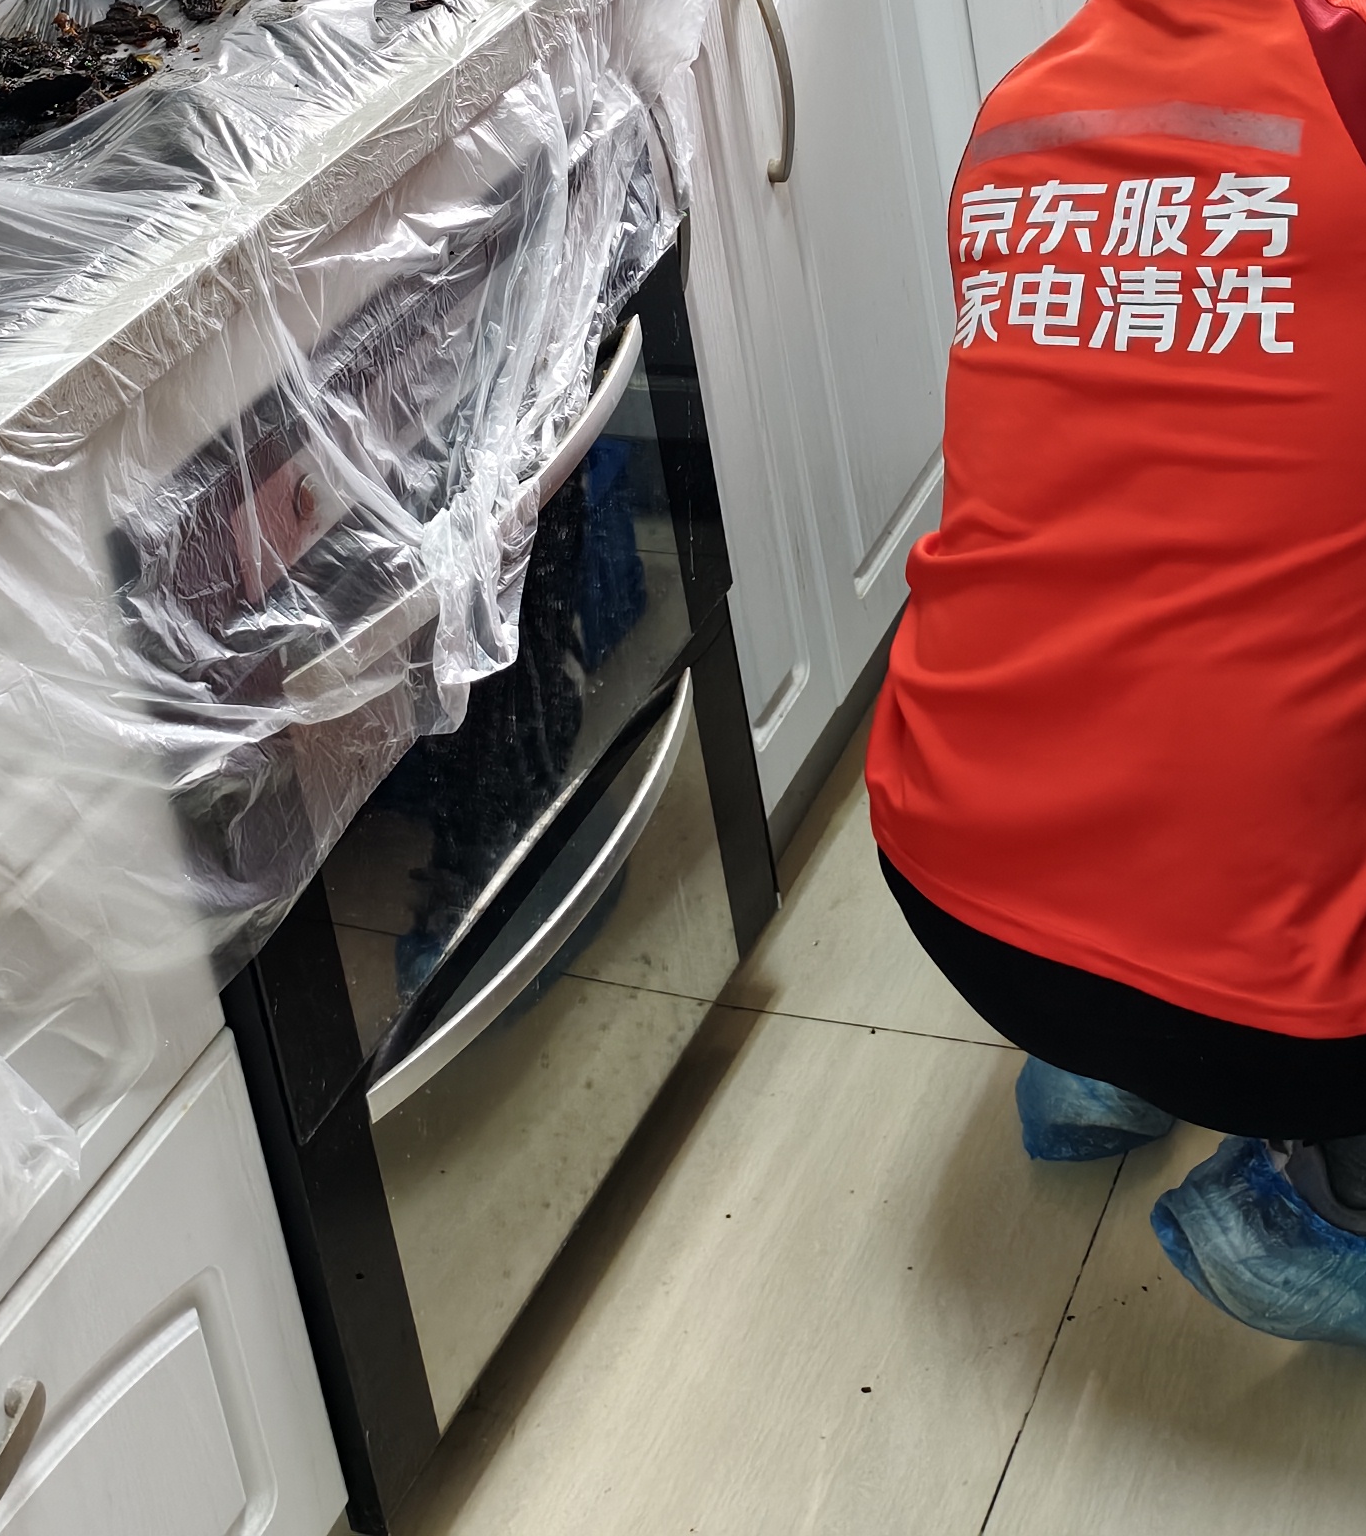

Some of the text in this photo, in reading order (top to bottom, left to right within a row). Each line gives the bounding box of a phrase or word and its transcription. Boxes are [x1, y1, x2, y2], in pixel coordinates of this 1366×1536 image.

[959, 172, 1299, 262] 京东服务
[953, 264, 1295, 354] 家电清洗
